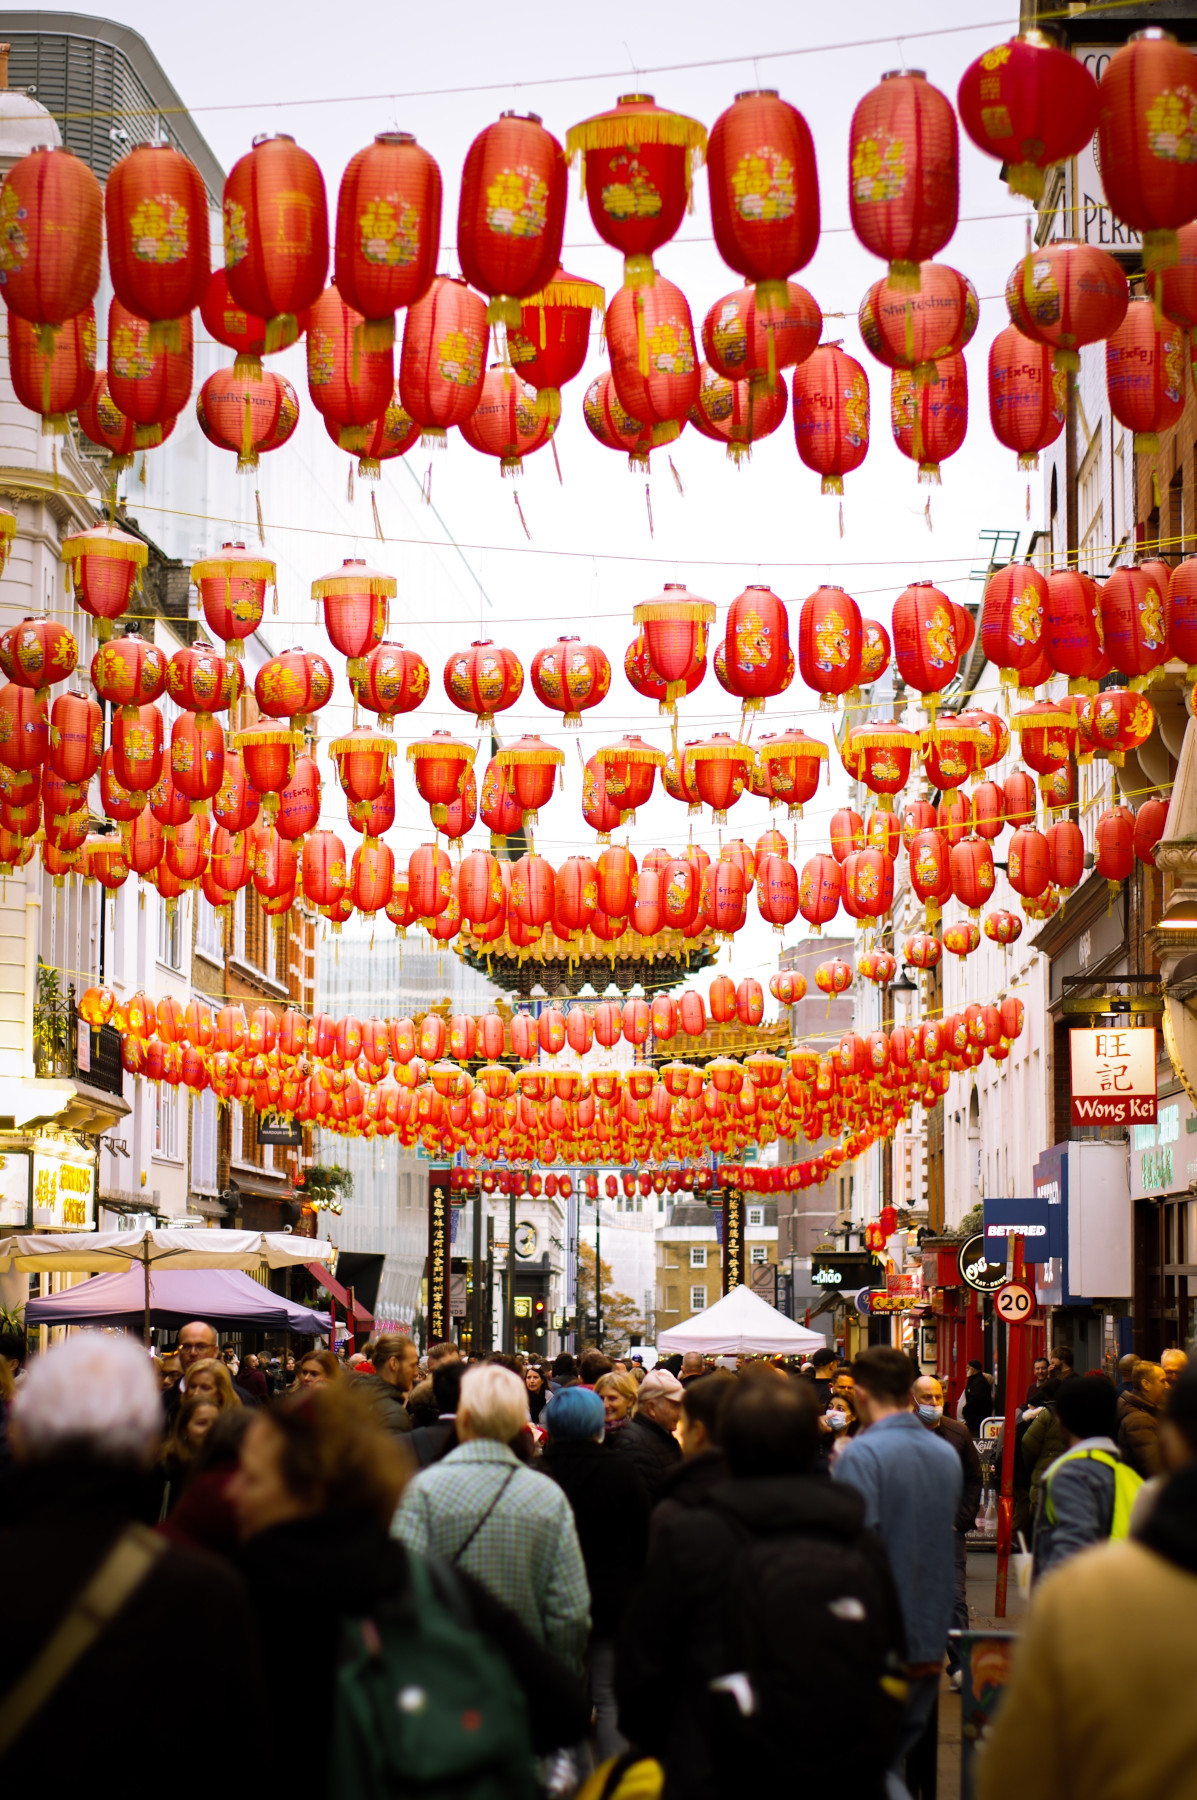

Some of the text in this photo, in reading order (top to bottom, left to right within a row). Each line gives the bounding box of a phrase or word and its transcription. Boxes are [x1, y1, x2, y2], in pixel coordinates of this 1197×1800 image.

[1095, 1033, 1134, 1092] 旺記
[1074, 1098, 1155, 1122] Wong Kei
[987, 1225, 1046, 1237] BETFRED
[1000, 1293, 1029, 1312] 20
